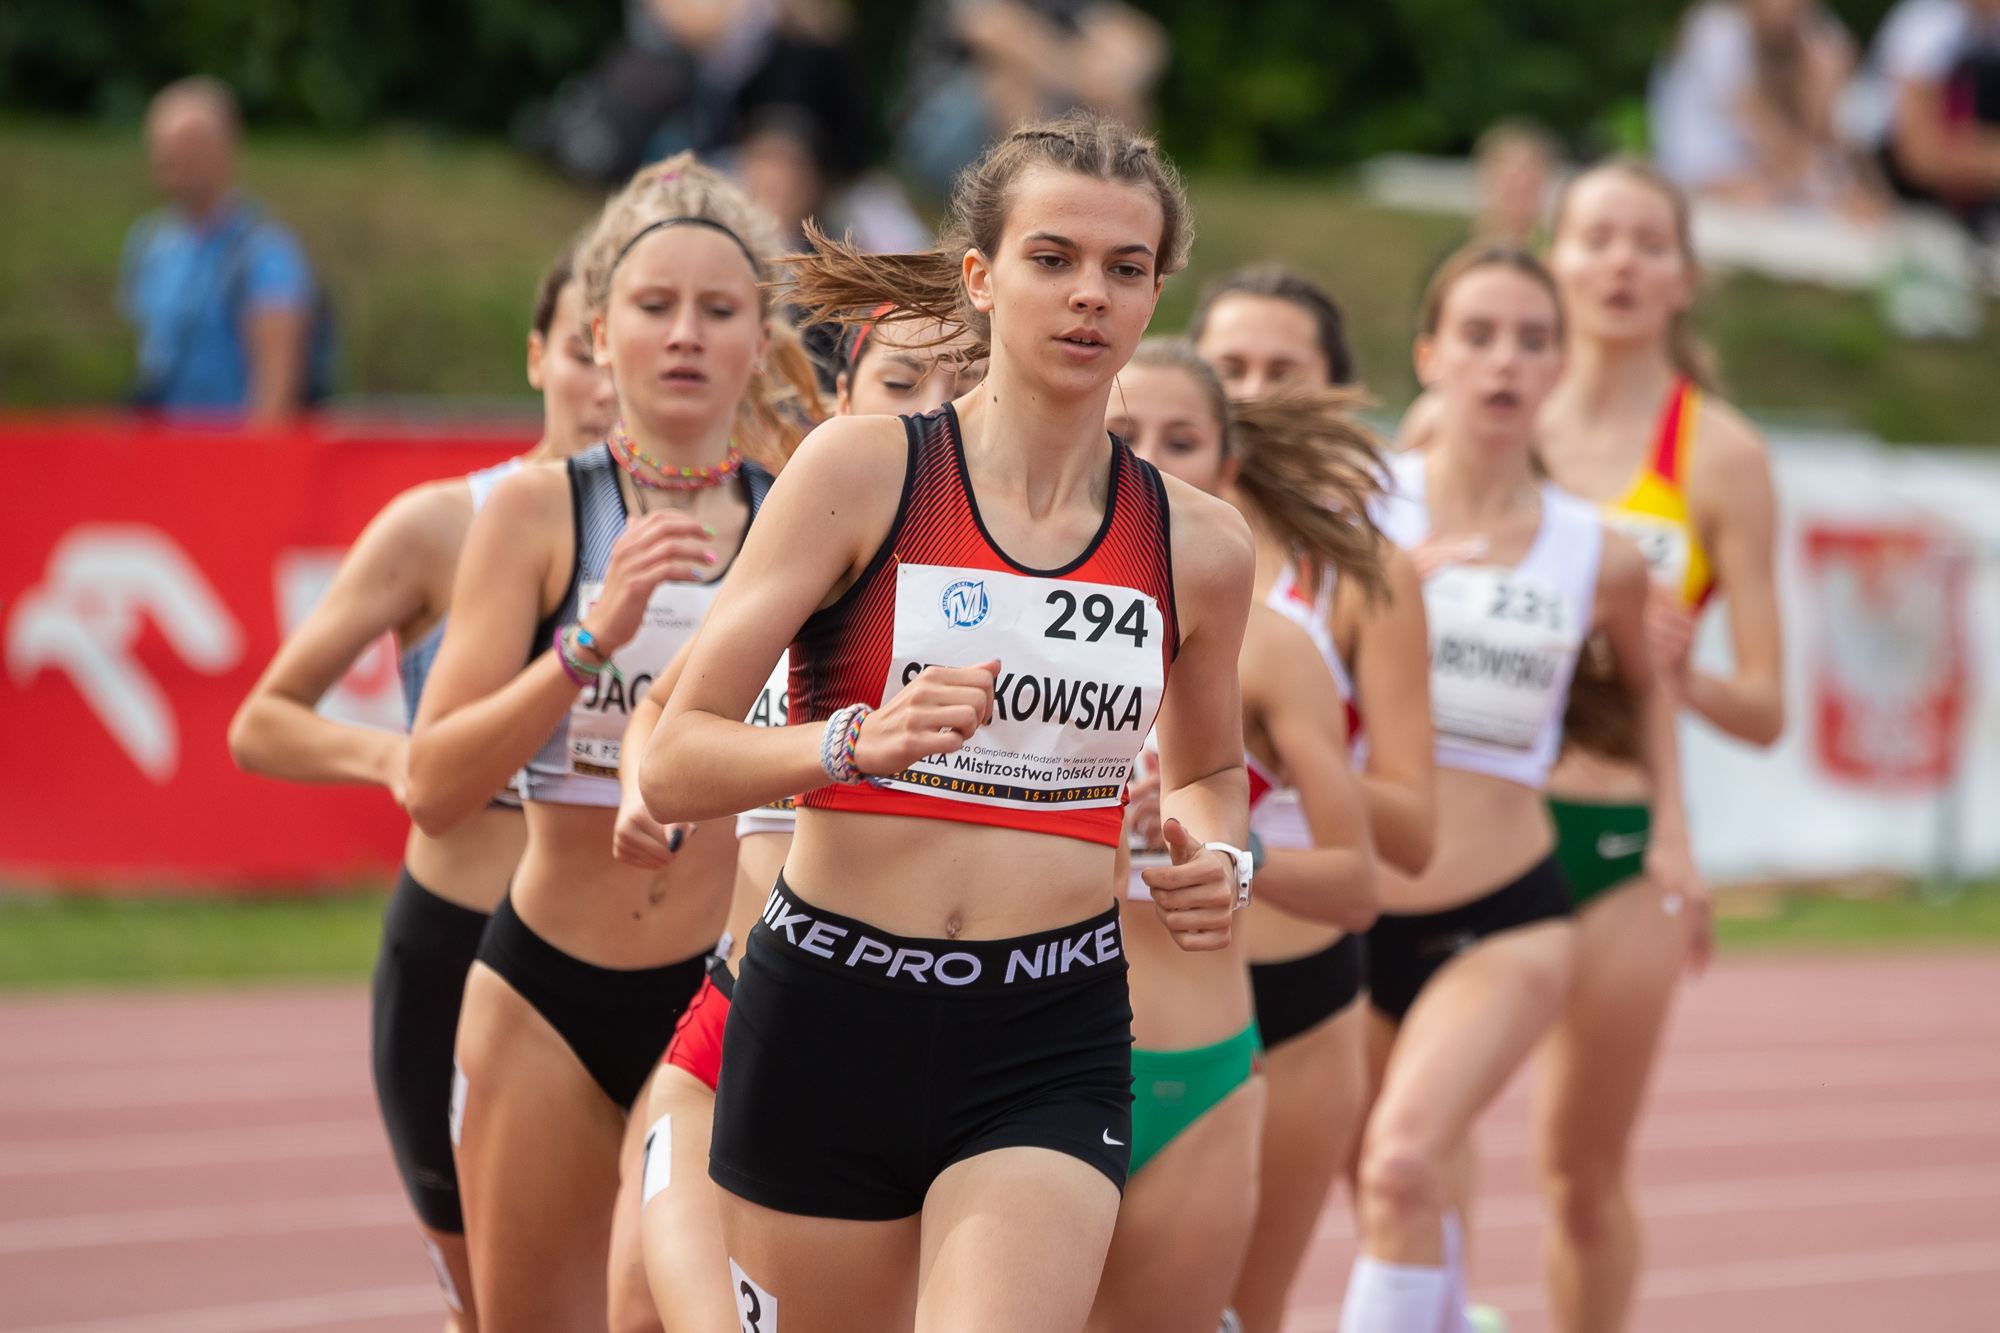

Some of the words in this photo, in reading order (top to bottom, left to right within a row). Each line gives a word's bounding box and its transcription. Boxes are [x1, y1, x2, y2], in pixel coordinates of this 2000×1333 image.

[1044, 589, 1148, 648] 294
[974, 746, 1019, 759] Olimpiada
[954, 755, 1052, 781] Mistrzostwa
[1056, 766, 1095, 781] Polski
[1098, 766, 1126, 778] U18
[1024, 787, 1115, 801] 15-17.07.2022
[845, 936, 982, 986] PRO
[1004, 921, 1120, 984] NIKE
